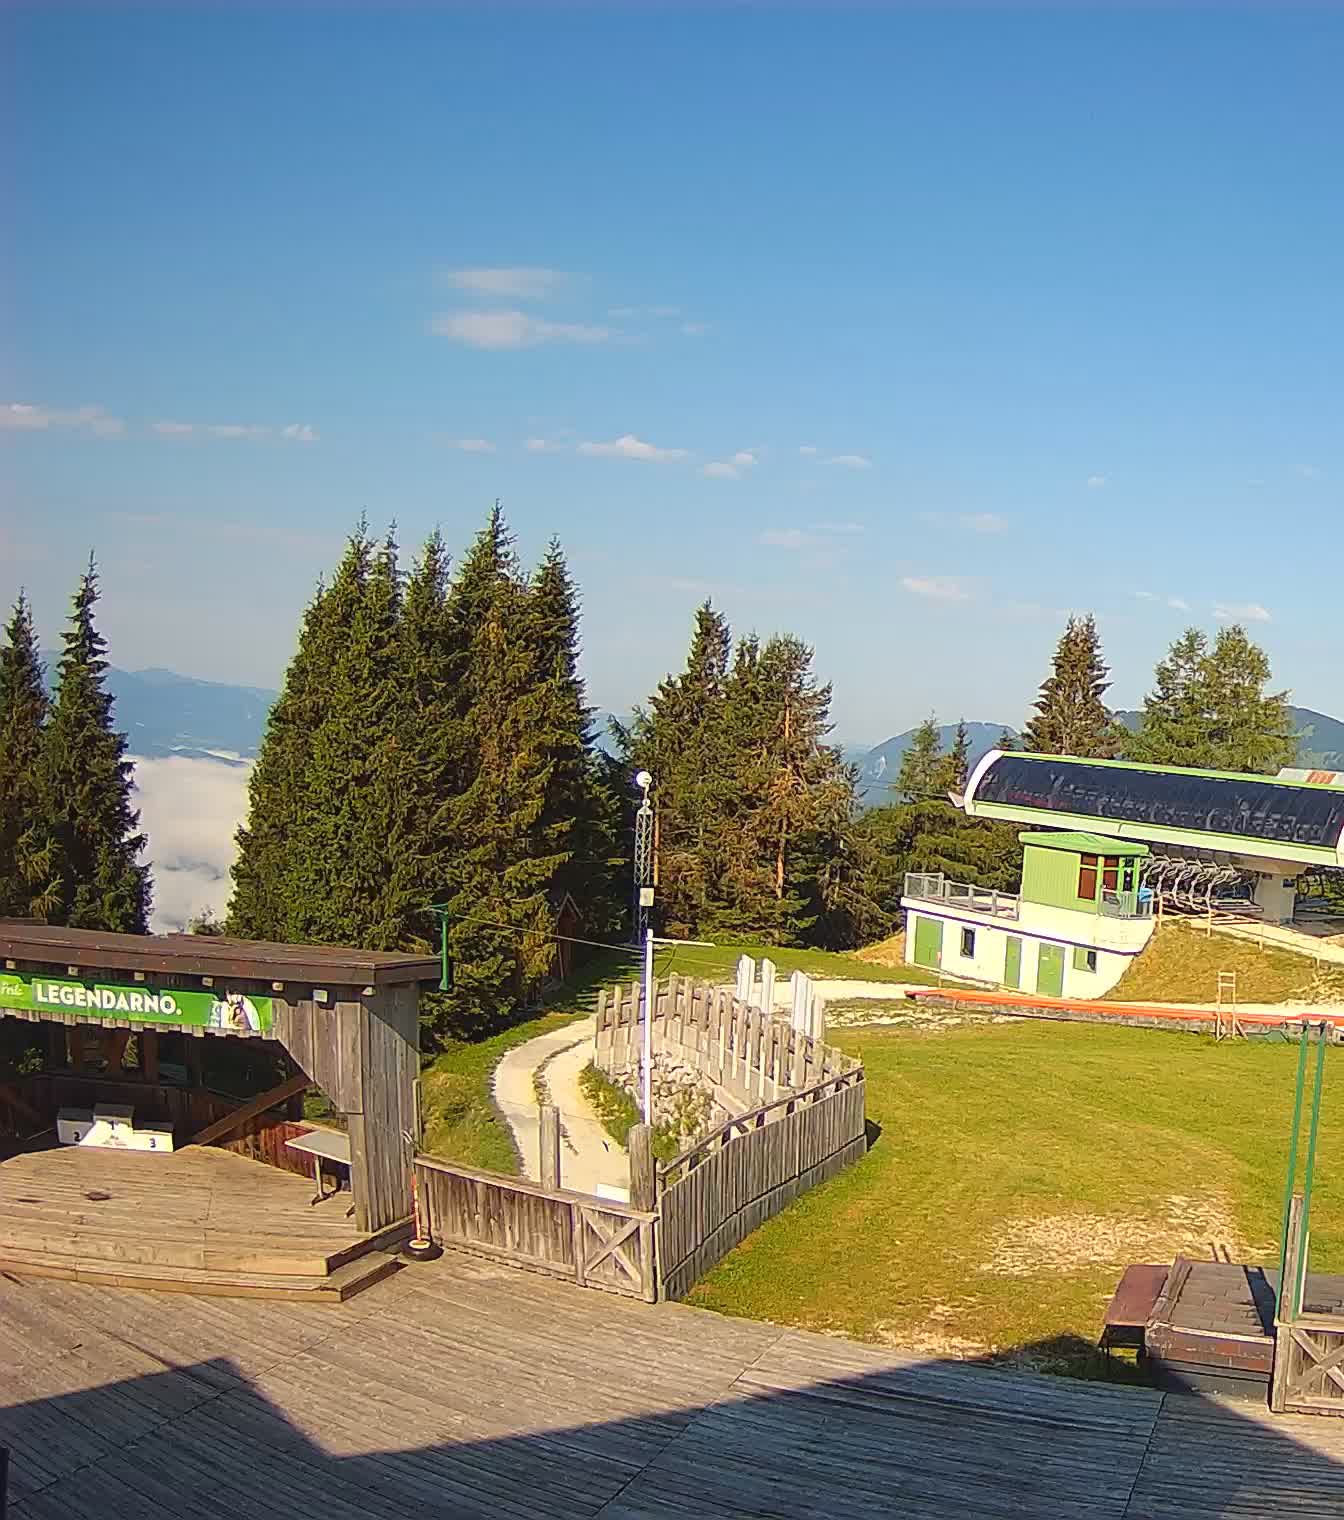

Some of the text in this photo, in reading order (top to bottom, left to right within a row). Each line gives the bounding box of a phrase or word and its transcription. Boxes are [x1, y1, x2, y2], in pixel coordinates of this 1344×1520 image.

[36, 983, 183, 1015] LEGENDARNO.
[73, 1131, 81, 1142] 2
[149, 1138, 156, 1148] 3
